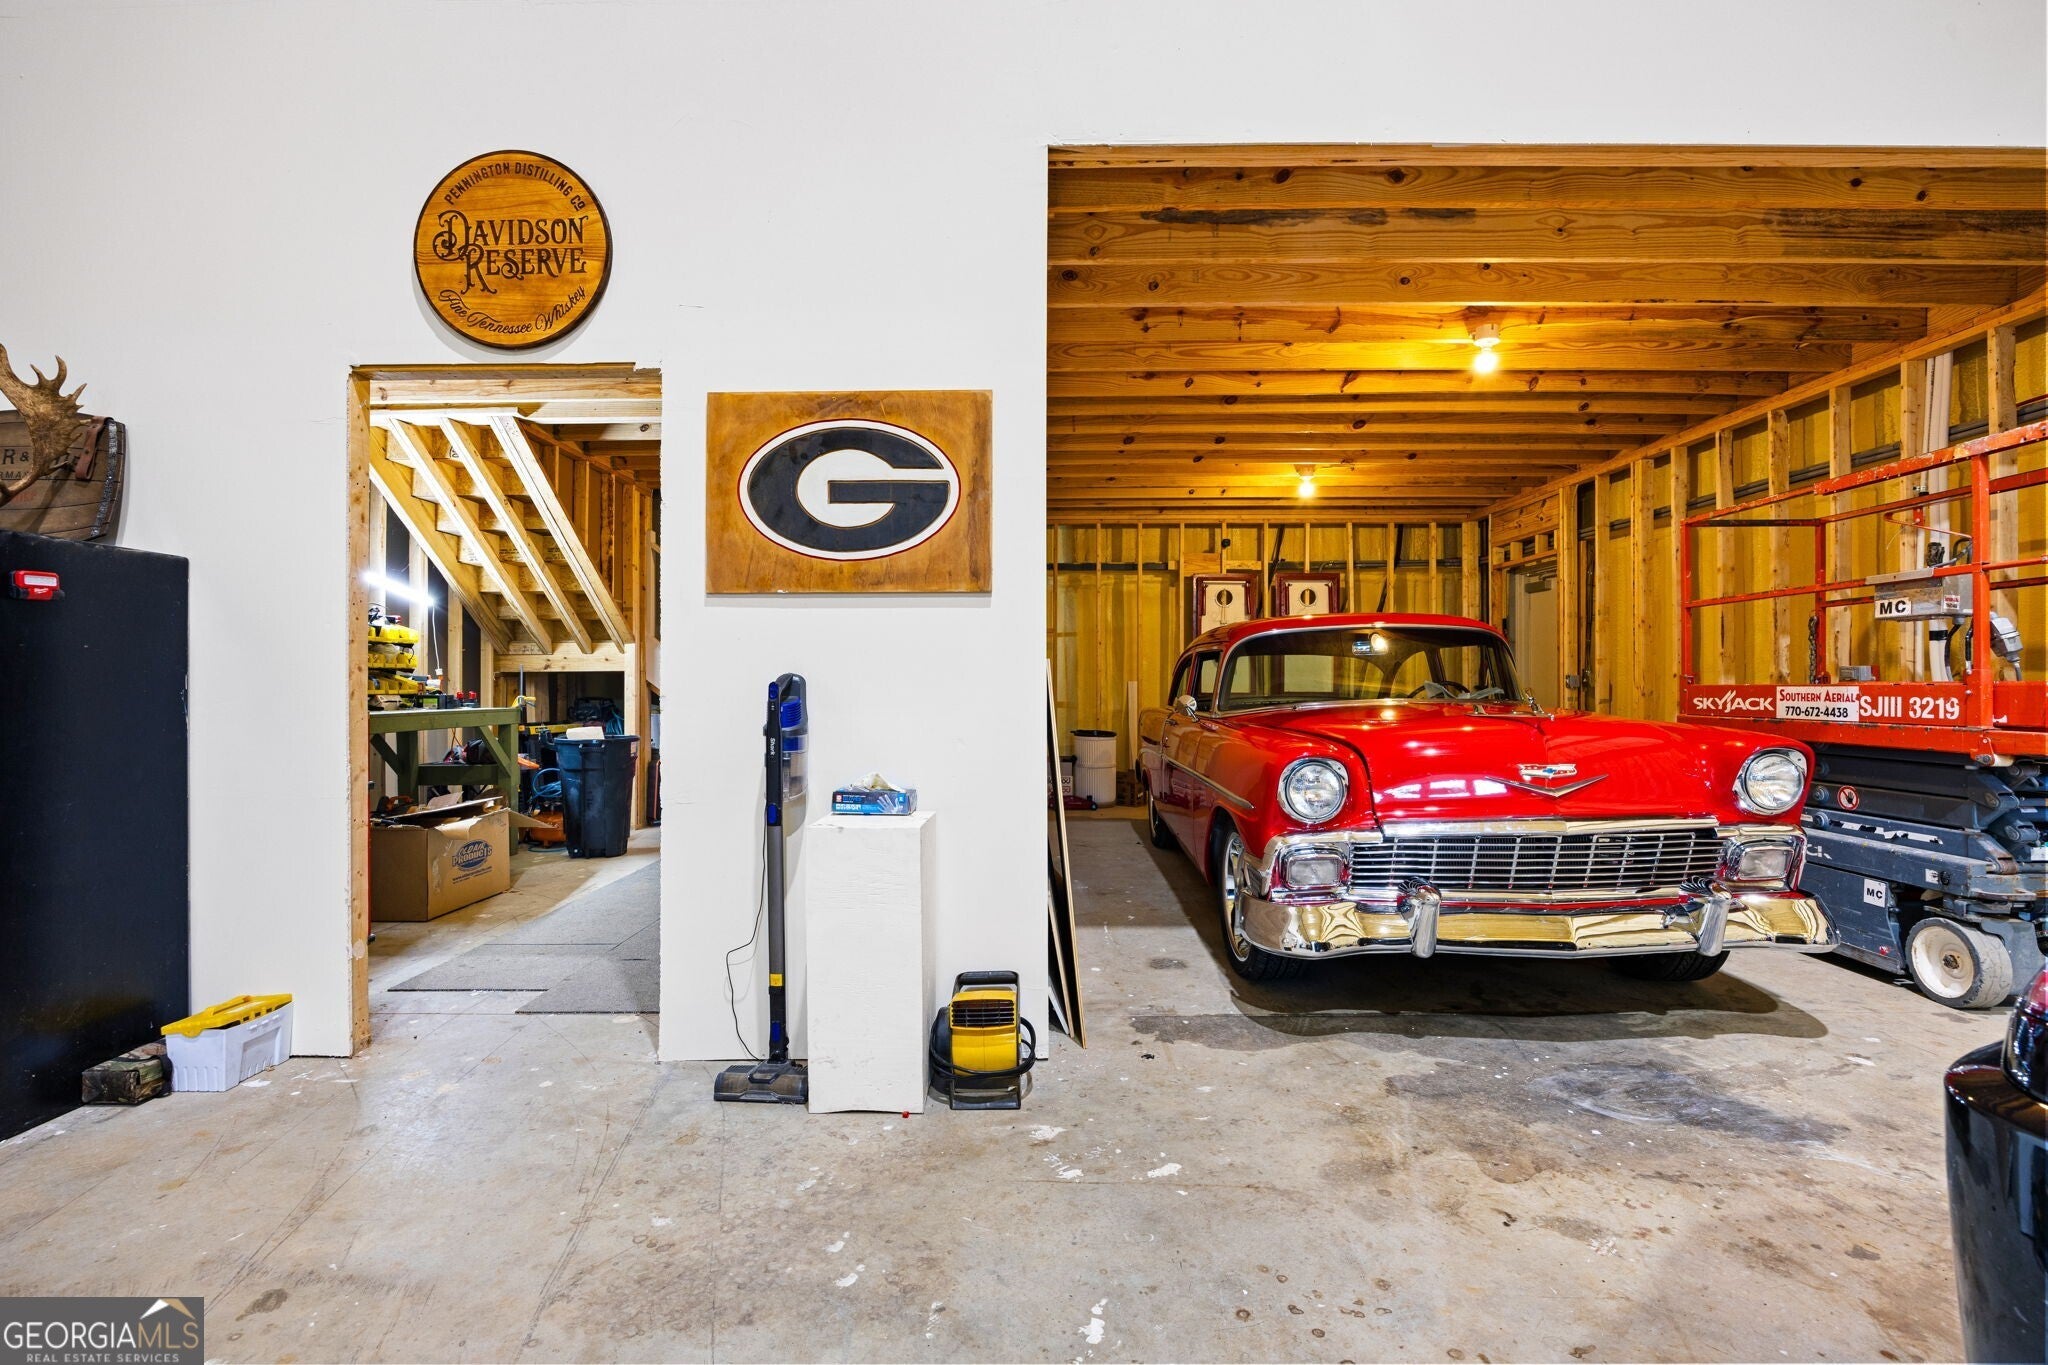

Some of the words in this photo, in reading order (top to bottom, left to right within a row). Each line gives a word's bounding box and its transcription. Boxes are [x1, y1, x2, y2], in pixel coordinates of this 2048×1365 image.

[444, 162, 510, 206] PENNINGTON
[515, 162, 573, 196] DISTILLING
[433, 209, 589, 261] DAVIDSON
[458, 243, 587, 295] RESERVE
[438, 289, 471, 318] Fine
[466, 311, 533, 334] Tennessee
[535, 285, 586, 332] Whiskey
[747, 426, 951, 552] G
[1693, 690, 1775, 713] SKYJACK
[1779, 689, 1821, 703] SOUTHERN
[1859, 695, 1902, 718] SJIII
[1909, 696, 1960, 720] 3219
[1785, 706, 1849, 718] 770-672-4438
[452, 846, 493, 867] PRODUCTS
[1866, 887, 1883, 899] MC
